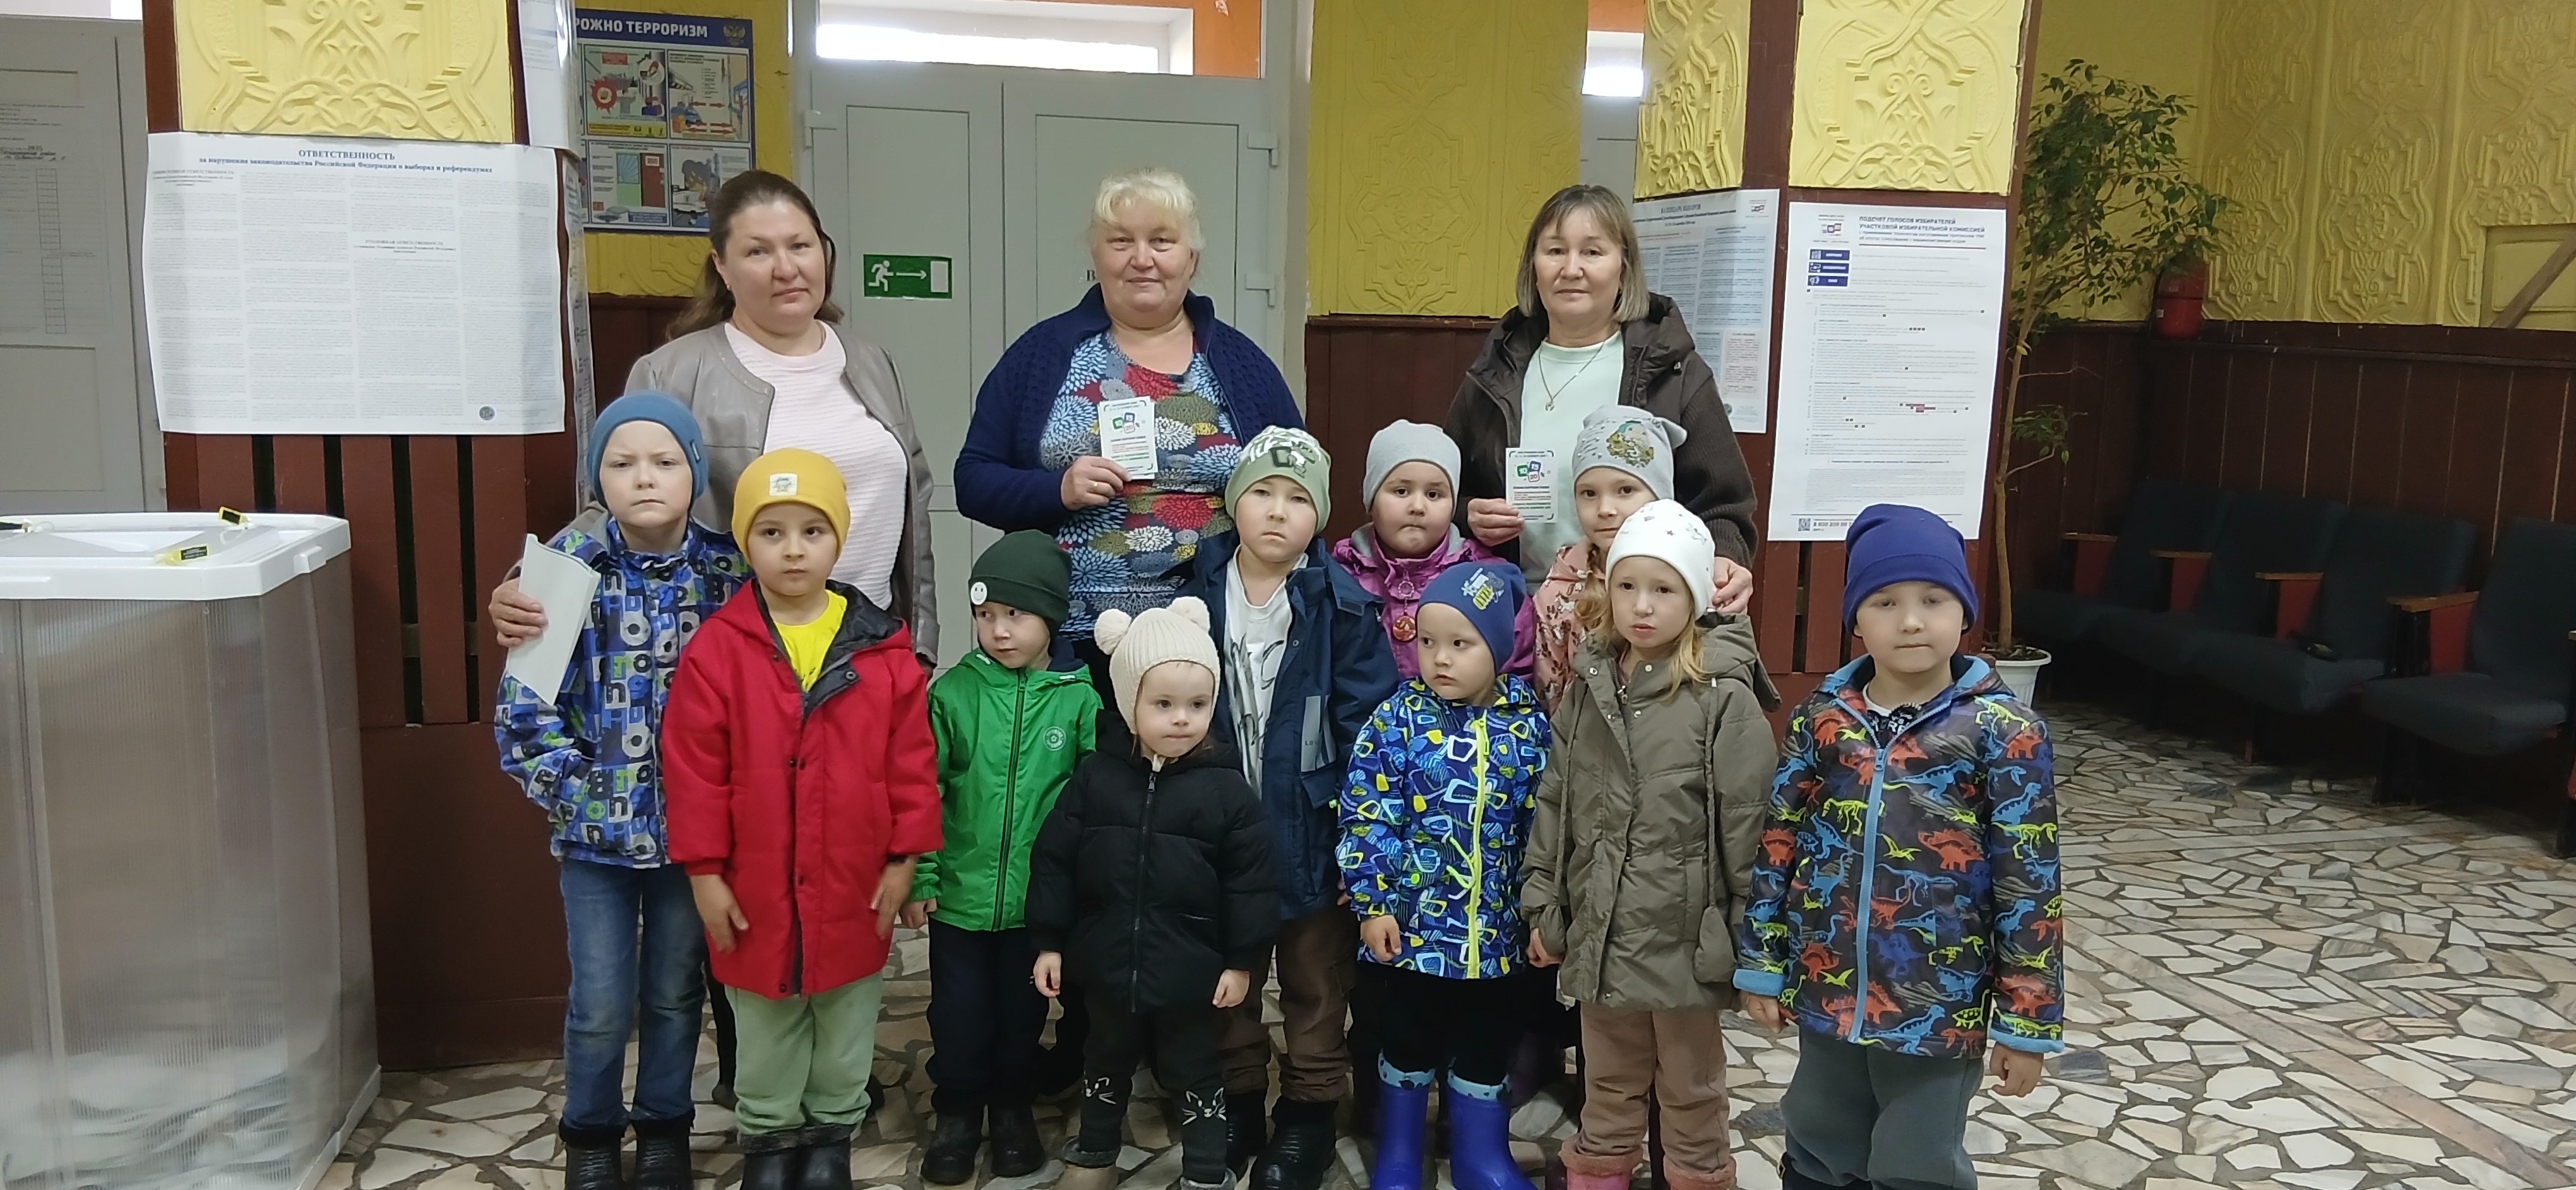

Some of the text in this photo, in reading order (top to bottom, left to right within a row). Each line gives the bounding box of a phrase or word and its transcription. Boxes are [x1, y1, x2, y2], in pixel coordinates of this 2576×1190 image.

[626, 21, 708, 38] ТЕРРОРИЗМ
[298, 150, 395, 160] ОТВЕТСТВЕННОСТЬ
[314, 160, 355, 168] Российской
